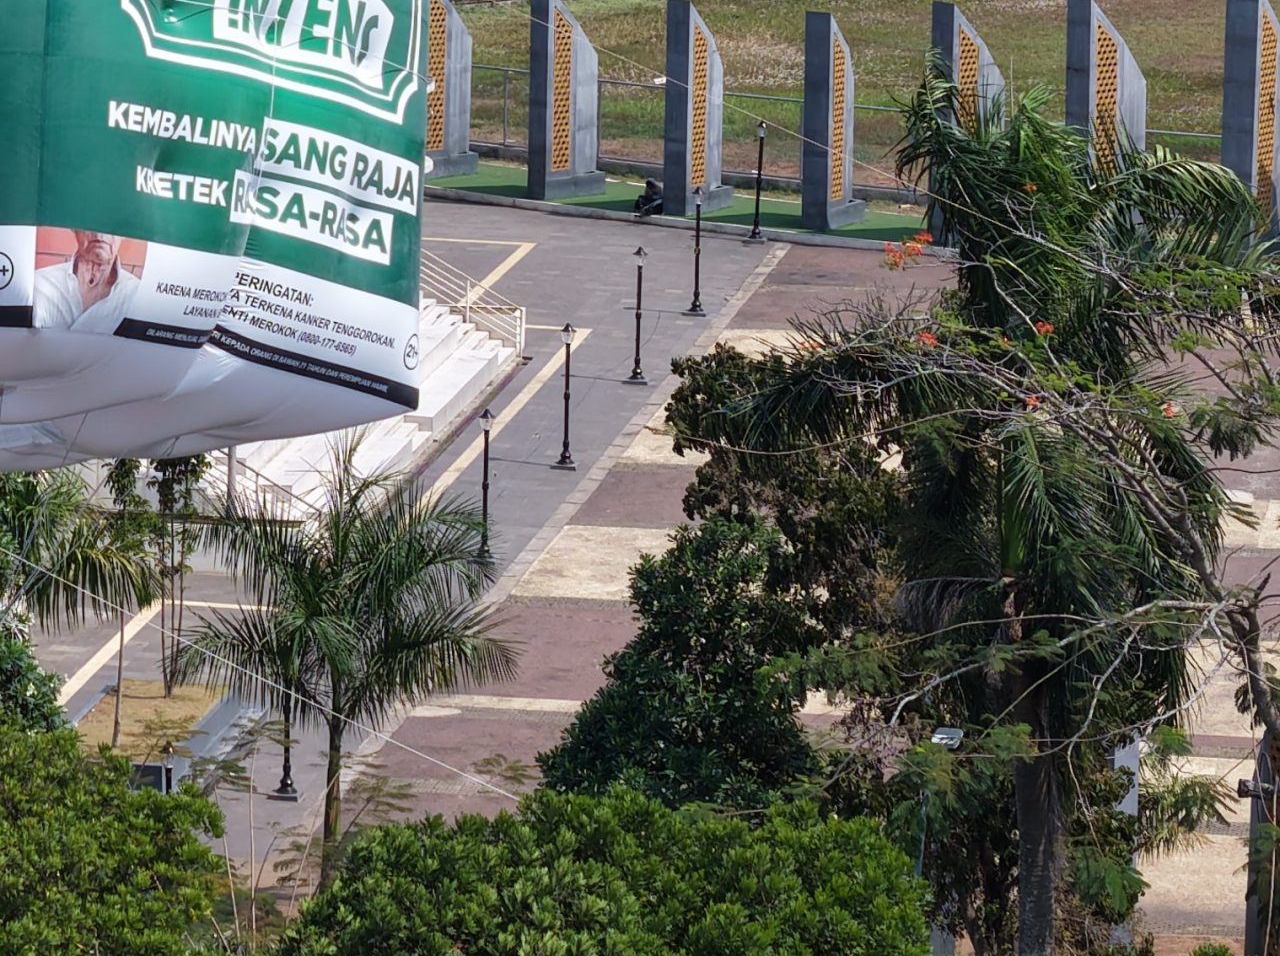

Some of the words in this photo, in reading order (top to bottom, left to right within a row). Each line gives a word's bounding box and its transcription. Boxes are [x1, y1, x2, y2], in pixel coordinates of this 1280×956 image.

[108, 100, 257, 154] KEMBALINYA
[263, 126, 347, 189] SANG
[350, 152, 416, 206] RAJA
[136, 165, 228, 207] KRETEK
[235, 176, 388, 254] RASA-RASA
[156, 281, 191, 299] KARENA
[244, 294, 294, 321] TERKENA
[294, 310, 332, 331] KANKER
[331, 321, 395, 349] TENGGOROKAN.
[235, 272, 315, 307] ERINGATAN:
[221, 333, 251, 354] KEPADA
[249, 315, 299, 339] MEROKOK
